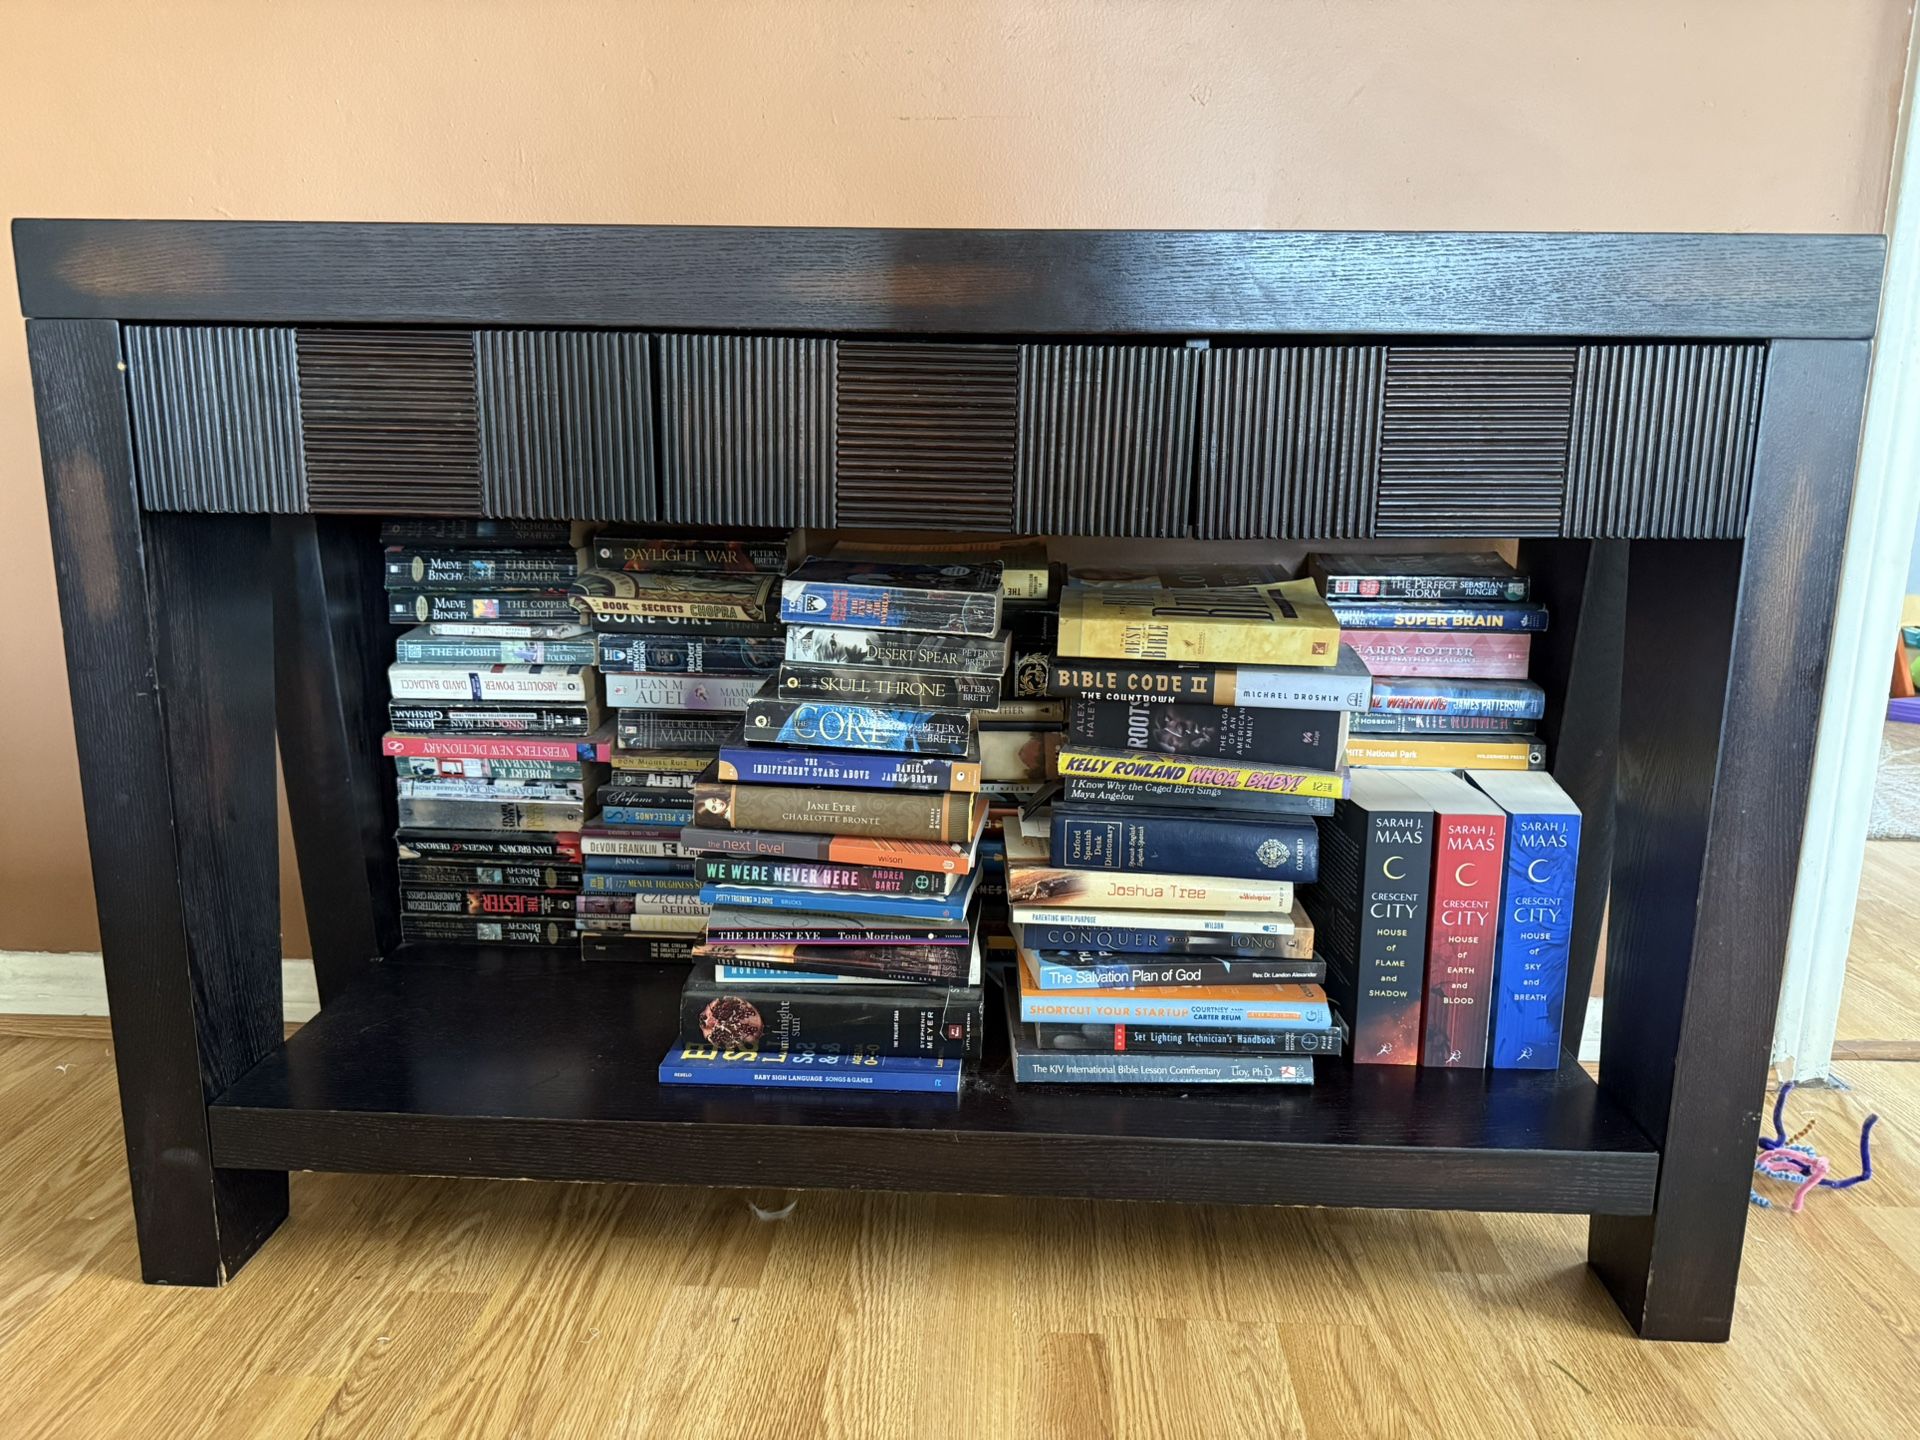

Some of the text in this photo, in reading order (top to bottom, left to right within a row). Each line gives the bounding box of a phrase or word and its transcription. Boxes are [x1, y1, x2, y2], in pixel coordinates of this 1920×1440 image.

[624, 548, 740, 564] DAYLIGHT WAR
[1390, 578, 1459, 591] THE PERFECT
[1404, 589, 1441, 599] STORM
[602, 601, 630, 614] BOOK
[640, 603, 685, 615] SECRETS
[689, 605, 739, 620] CHOPRA
[432, 609, 470, 622] BINCHY
[1393, 612, 1504, 628] SUPER BRAIN
[1124, 626, 1141, 654] BEST
[1140, 625, 1169, 659] BIBLE
[454, 646, 498, 659] HOBBIT
[866, 644, 959, 665] DESERT SPEAR
[1415, 646, 1474, 657] POTTER
[401, 679, 441, 690] BALDACCI
[442, 679, 467, 690] DAVID
[484, 680, 515, 691] POWER
[516, 680, 558, 692] ABSOLUTE
[635, 678, 668, 690] JEAN
[1057, 669, 1182, 692] BIBLE CODE
[820, 676, 947, 699] SKULL THRONE
[636, 690, 687, 705] AUEL
[1081, 690, 1177, 704] THE COUNTDOWN
[1243, 690, 1289, 700] MICHAEL
[1386, 696, 1525, 712] WARNING JAMES PATTERSON
[395, 709, 443, 720] GRISHAM
[406, 719, 435, 730] JOHN
[922, 722, 956, 734] PETER
[659, 729, 717, 743] MARTIN
[927, 734, 962, 745] BRETT
[422, 742, 514, 757] NEW DICTIONARY
[1365, 749, 1417, 759] National Park
[805, 759, 818, 767] THE
[895, 763, 925, 775] DANIEL
[510, 768, 552, 780] ROBERT
[752, 764, 870, 781] INDIFFERENT STARS ABOVE
[881, 772, 939, 785] JAMES BROWN
[1066, 757, 1110, 774] KELLY
[1112, 760, 1187, 781] ROWLAND
[1244, 772, 1306, 793] BABY!
[1076, 780, 1222, 799] Know Why the Caged Bird Sings
[1071, 790, 1134, 804] Maya Angelou
[805, 800, 857, 814] JANE EYRE
[782, 812, 841, 825] CHARLOTTE
[1375, 817, 1424, 829] SARAH J.
[1448, 825, 1496, 837] SARAH J.
[1521, 822, 1568, 833] SARAH J.
[1375, 830, 1424, 845] MAAS
[1447, 837, 1495, 851] MAAS
[1520, 834, 1568, 849] MAAS
[415, 842, 494, 853] ANGELS DEMONS
[498, 844, 554, 856] DAN BROWN
[618, 842, 658, 855] FRANKLIN
[708, 837, 785, 855] the next level
[1072, 830, 1081, 859] Oxford
[1083, 829, 1093, 861] Spanish
[1104, 823, 1115, 867] Dictionary
[705, 861, 860, 888] WE WERE NEVER HERE
[871, 870, 906, 882] ANDREA
[875, 880, 903, 893] BARTZ
[1106, 882, 1207, 901] Joshua Tree
[482, 893, 529, 913] JESTER
[641, 893, 683, 904] CZECH
[1371, 892, 1419, 903] CRESCENT
[1515, 896, 1562, 907] CRESCENT
[1370, 903, 1419, 919] CITY
[1443, 899, 1490, 910] CRESCENT
[1441, 910, 1489, 926] CITY
[1513, 907, 1561, 924] CITY
[717, 930, 821, 941] THE BLUEST EYE
[837, 930, 912, 943] Toni Morrison
[1047, 930, 1160, 949] CONQUER
[1376, 928, 1408, 938] HOUSE
[1520, 932, 1551, 941] HOUSE
[1229, 932, 1276, 950] LONG
[1448, 935, 1479, 945] HOUSE
[1386, 943, 1396, 952] of
[1529, 946, 1539, 956] of
[1457, 951, 1467, 960] of
[1375, 958, 1405, 968] FLAME
[1524, 962, 1541, 971] SKY
[1252, 970, 1264, 979] Rev.
[1447, 966, 1475, 975] EARTH
[1049, 969, 1202, 986] The Salvation Plan of God
[1380, 973, 1397, 982] and
[1523, 978, 1540, 987] and
[1451, 981, 1468, 990] and
[1368, 989, 1408, 999] SHADOW
[1513, 993, 1547, 1002] BREATH
[1443, 997, 1474, 1006] BLOOD
[1029, 1004, 1189, 1018] SHORTCUT YOUR STARTUP
[1190, 1005, 1228, 1014] COURTNEY
[1192, 1013, 1219, 1022] CARTER
[1219, 1014, 1241, 1022] REUM
[775, 1000, 793, 1051] midnight
[790, 1016, 801, 1038] sun
[925, 1010, 934, 1050] MEYER
[1133, 1031, 1276, 1046] Set Lighting Technician's Handbook
[1031, 1062, 1221, 1079] The KJV International Bible Lesson Commentary
[754, 1073, 823, 1084] BABY SIGN LANGUAGE
